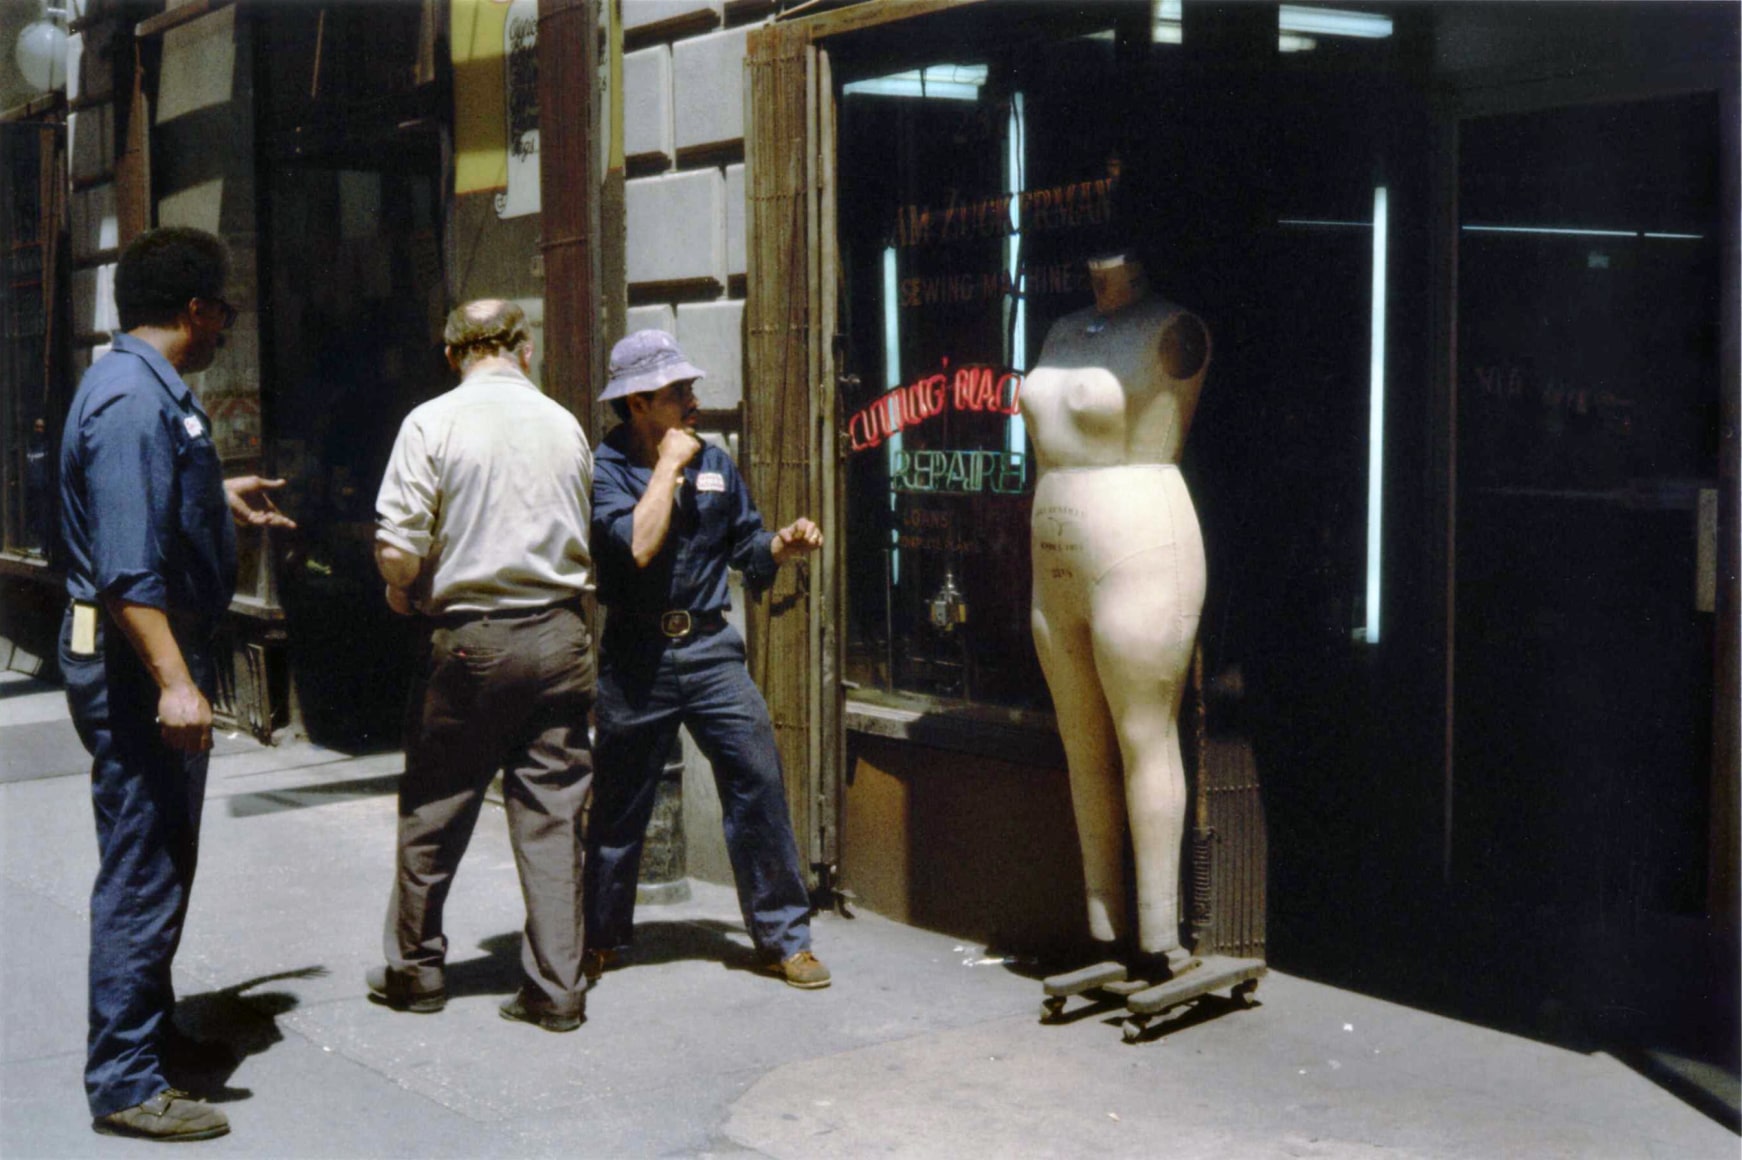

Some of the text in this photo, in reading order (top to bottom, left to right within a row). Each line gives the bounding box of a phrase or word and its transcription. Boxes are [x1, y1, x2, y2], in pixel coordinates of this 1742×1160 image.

[901, 264, 1077, 308] SEWING MAHINE
[849, 366, 1022, 451] CUTTING MAC
[893, 450, 1026, 494] REPAIRE
